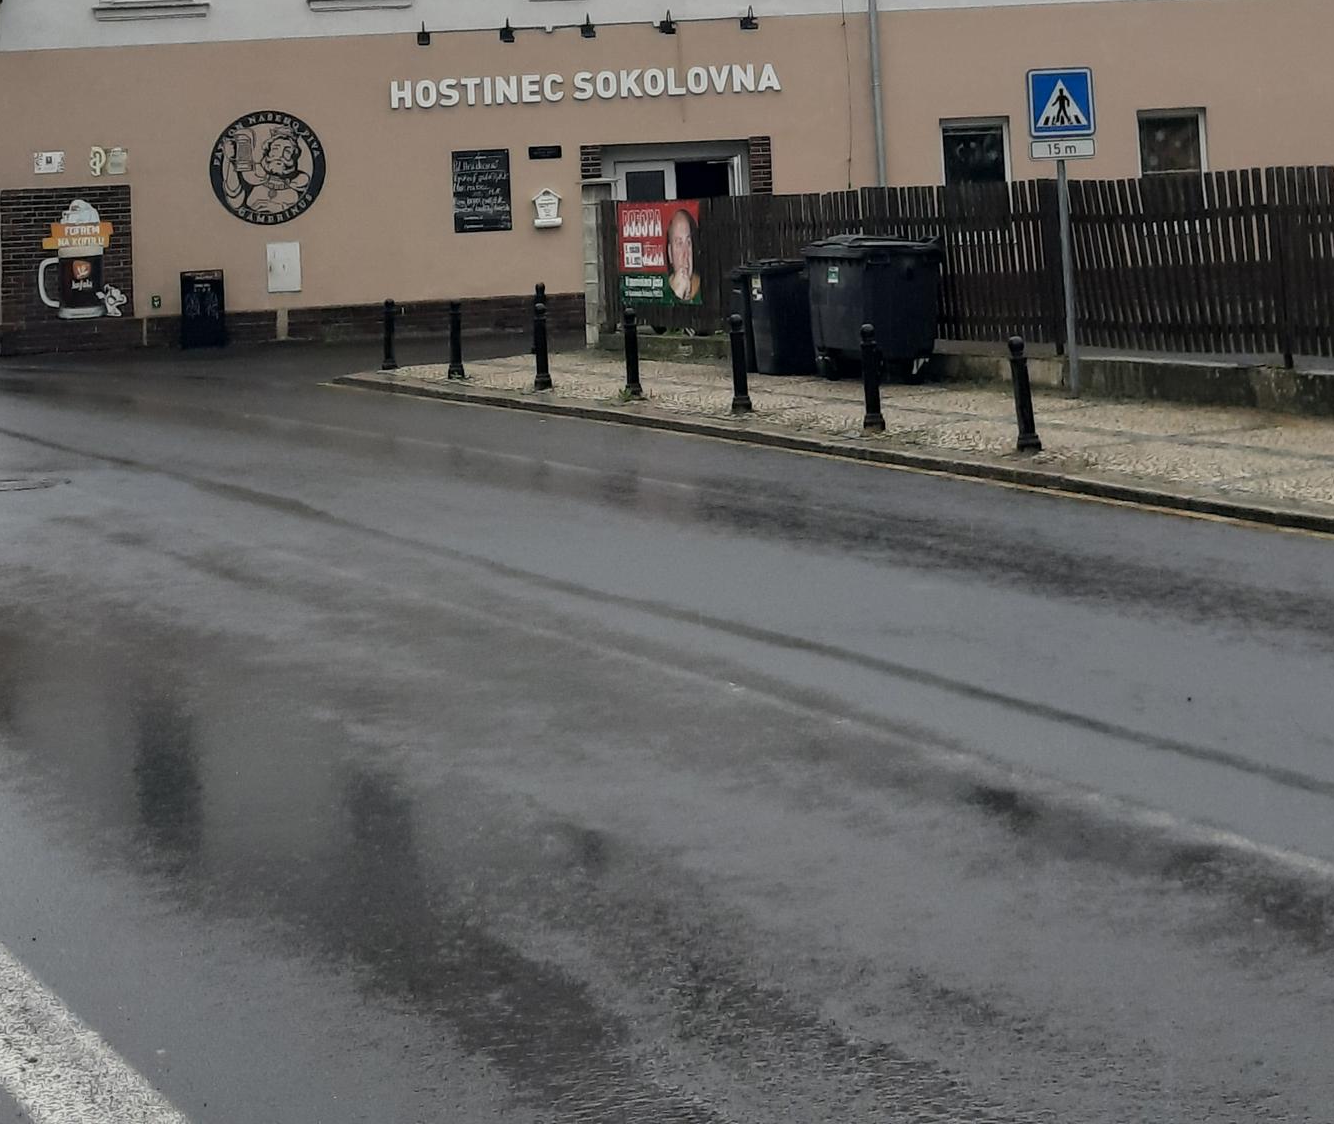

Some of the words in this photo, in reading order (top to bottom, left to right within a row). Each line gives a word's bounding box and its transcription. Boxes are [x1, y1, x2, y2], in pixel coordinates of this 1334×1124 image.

[390, 73, 564, 109] HOSTINEC
[572, 63, 781, 100] SOKOLOVNA
[1048, 143, 1061, 155] 15
[1065, 144, 1077, 154] m
[238, 193, 314, 223] GAMBRINUS
